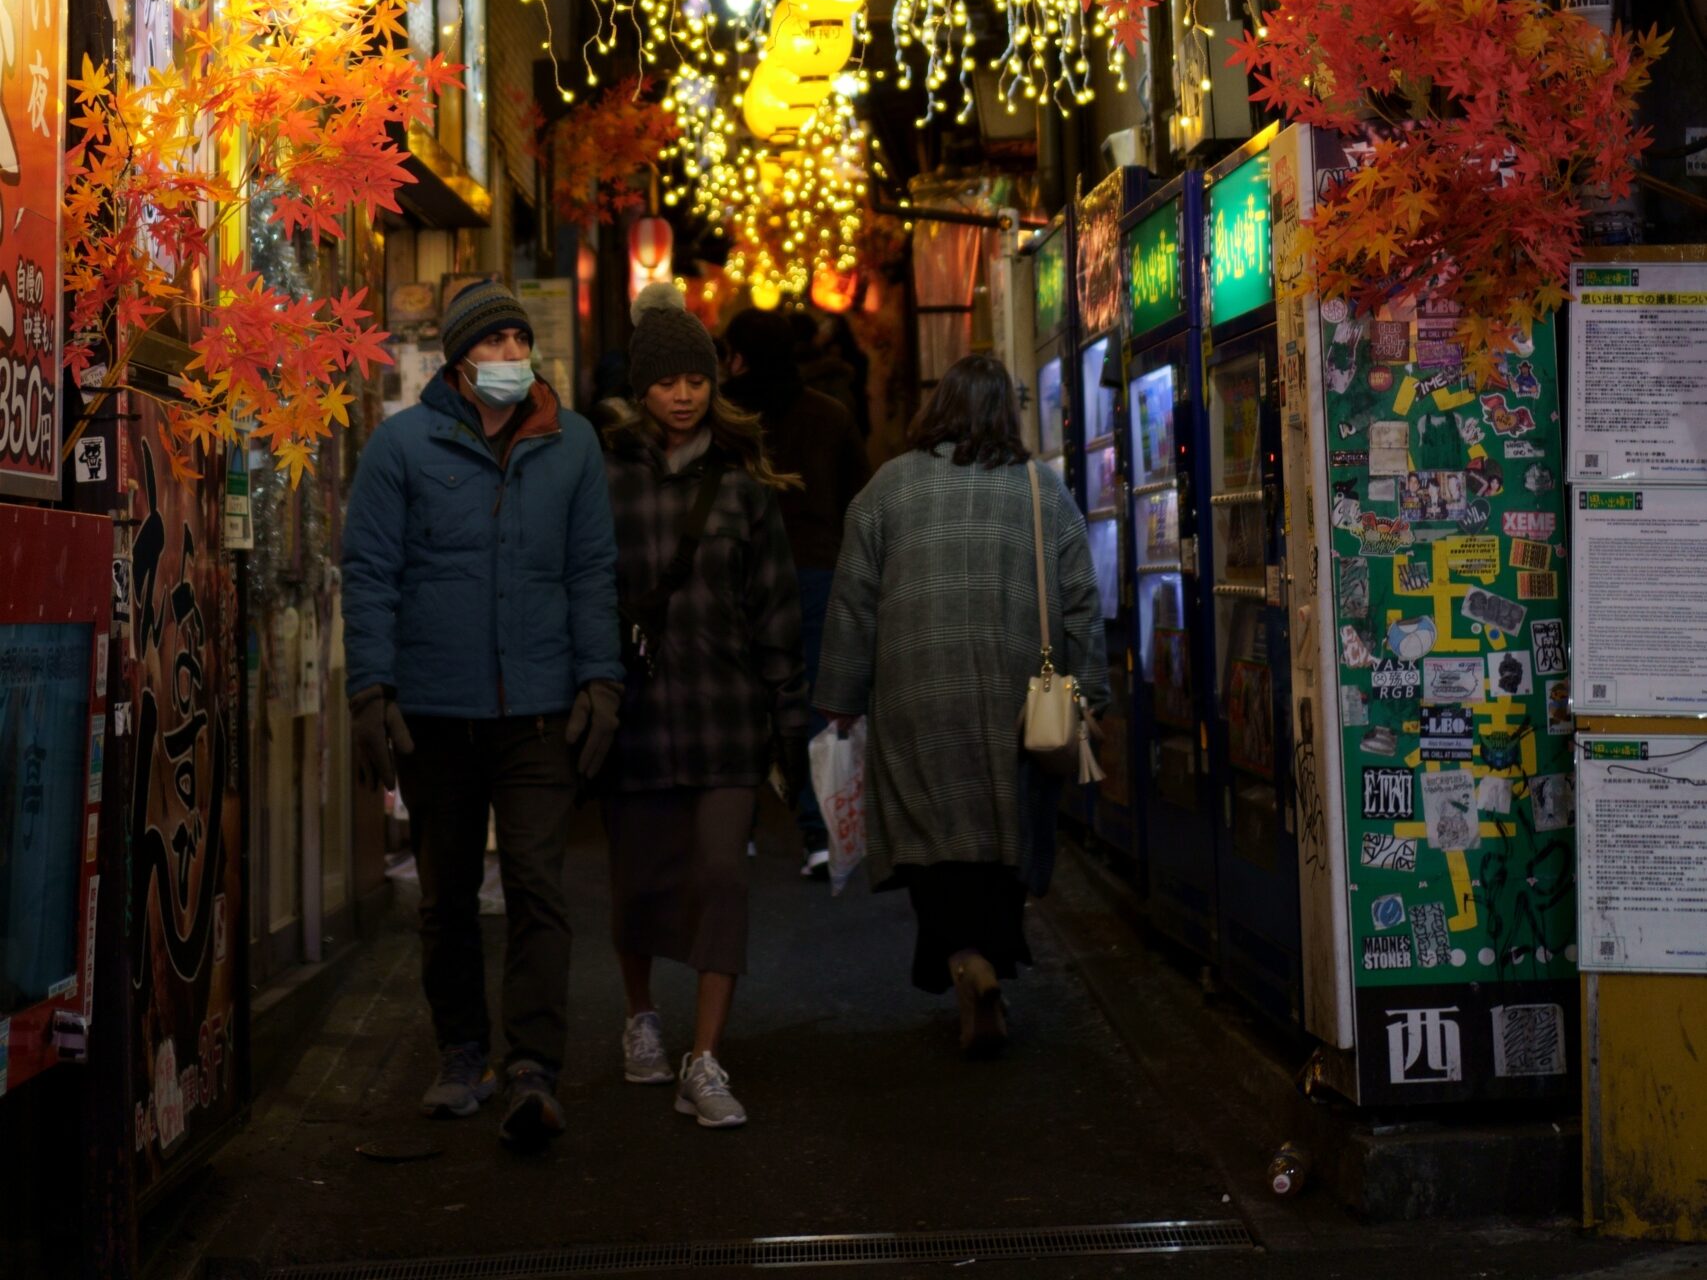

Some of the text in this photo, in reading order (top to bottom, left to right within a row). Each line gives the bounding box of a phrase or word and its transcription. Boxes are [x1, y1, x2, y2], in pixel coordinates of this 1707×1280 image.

[16, 260, 44, 304] 自慢の
[1379, 685, 1416, 699] RGB
[1429, 717, 1466, 733] LEO
[1363, 951, 1412, 970] STONER
